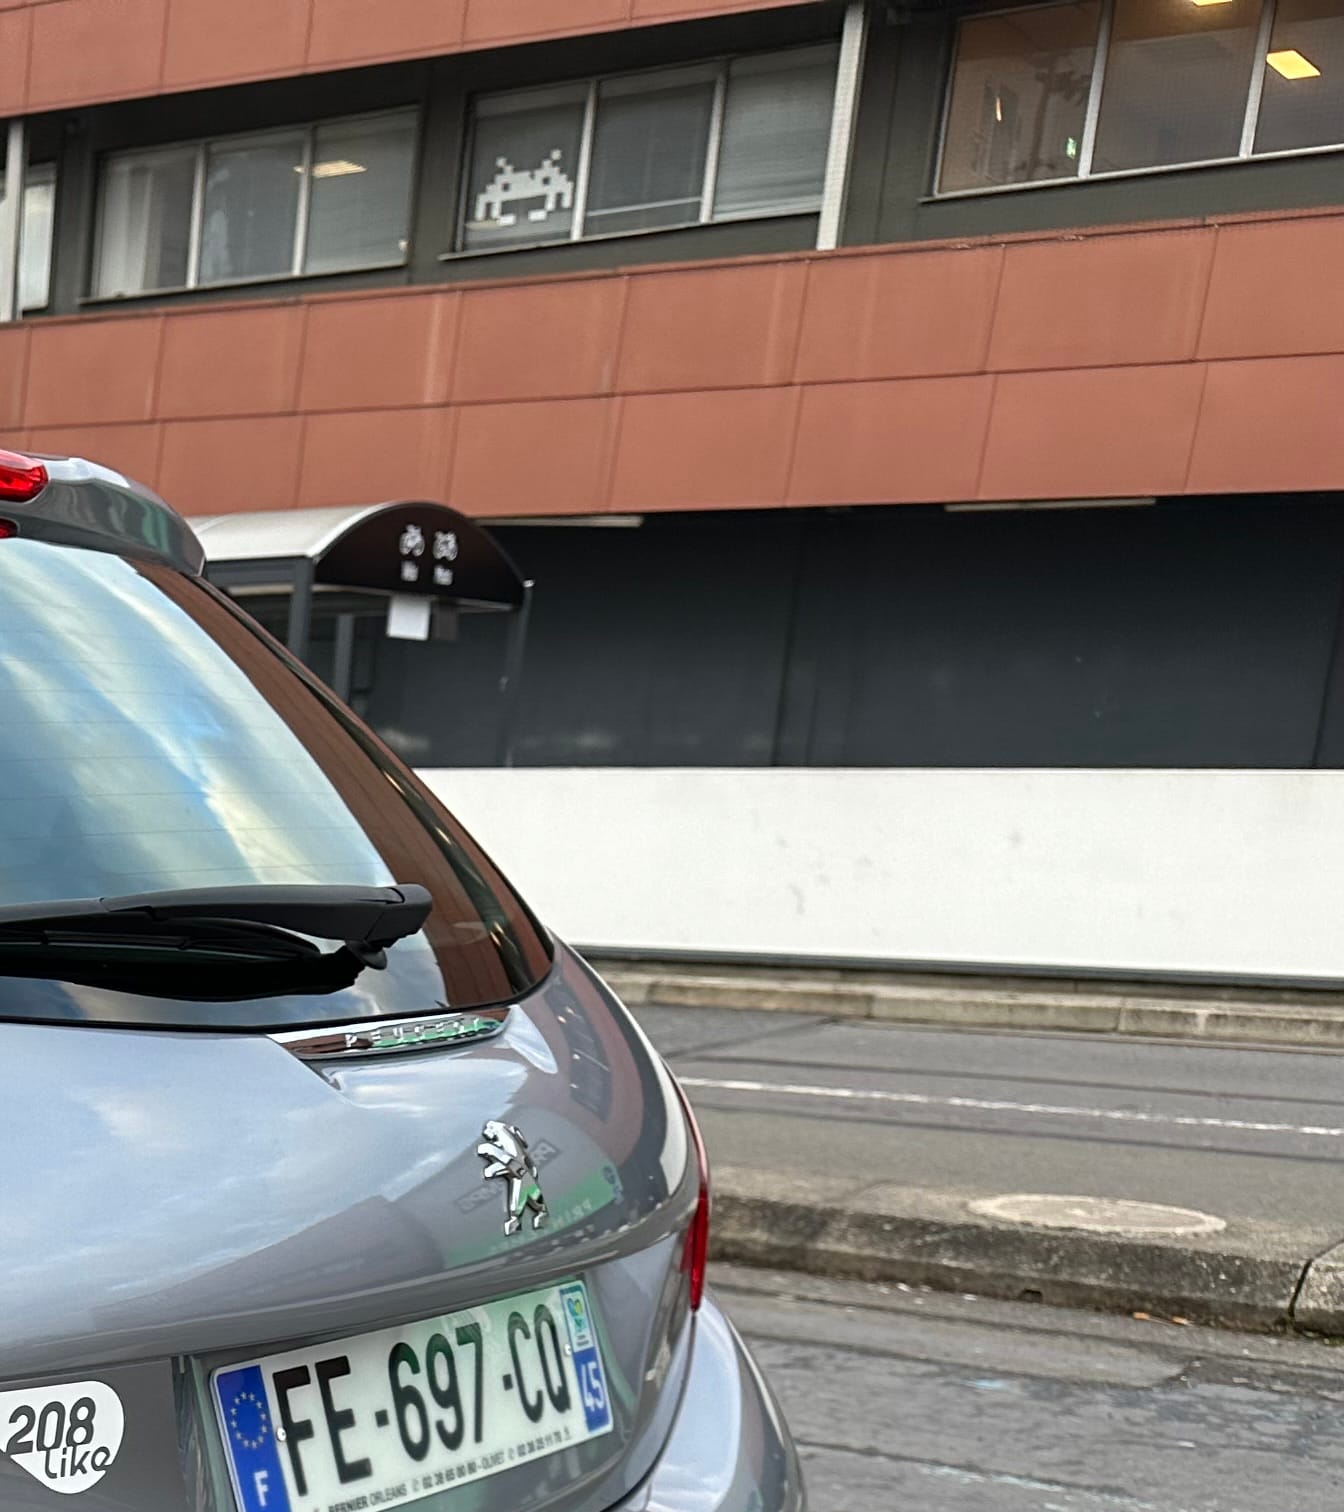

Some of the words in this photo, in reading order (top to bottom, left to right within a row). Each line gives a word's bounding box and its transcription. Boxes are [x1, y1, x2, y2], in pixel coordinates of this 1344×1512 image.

[581, 1361, 605, 1412] 45
[5, 1396, 96, 1455] 208
[253, 1470, 270, 1507] F
